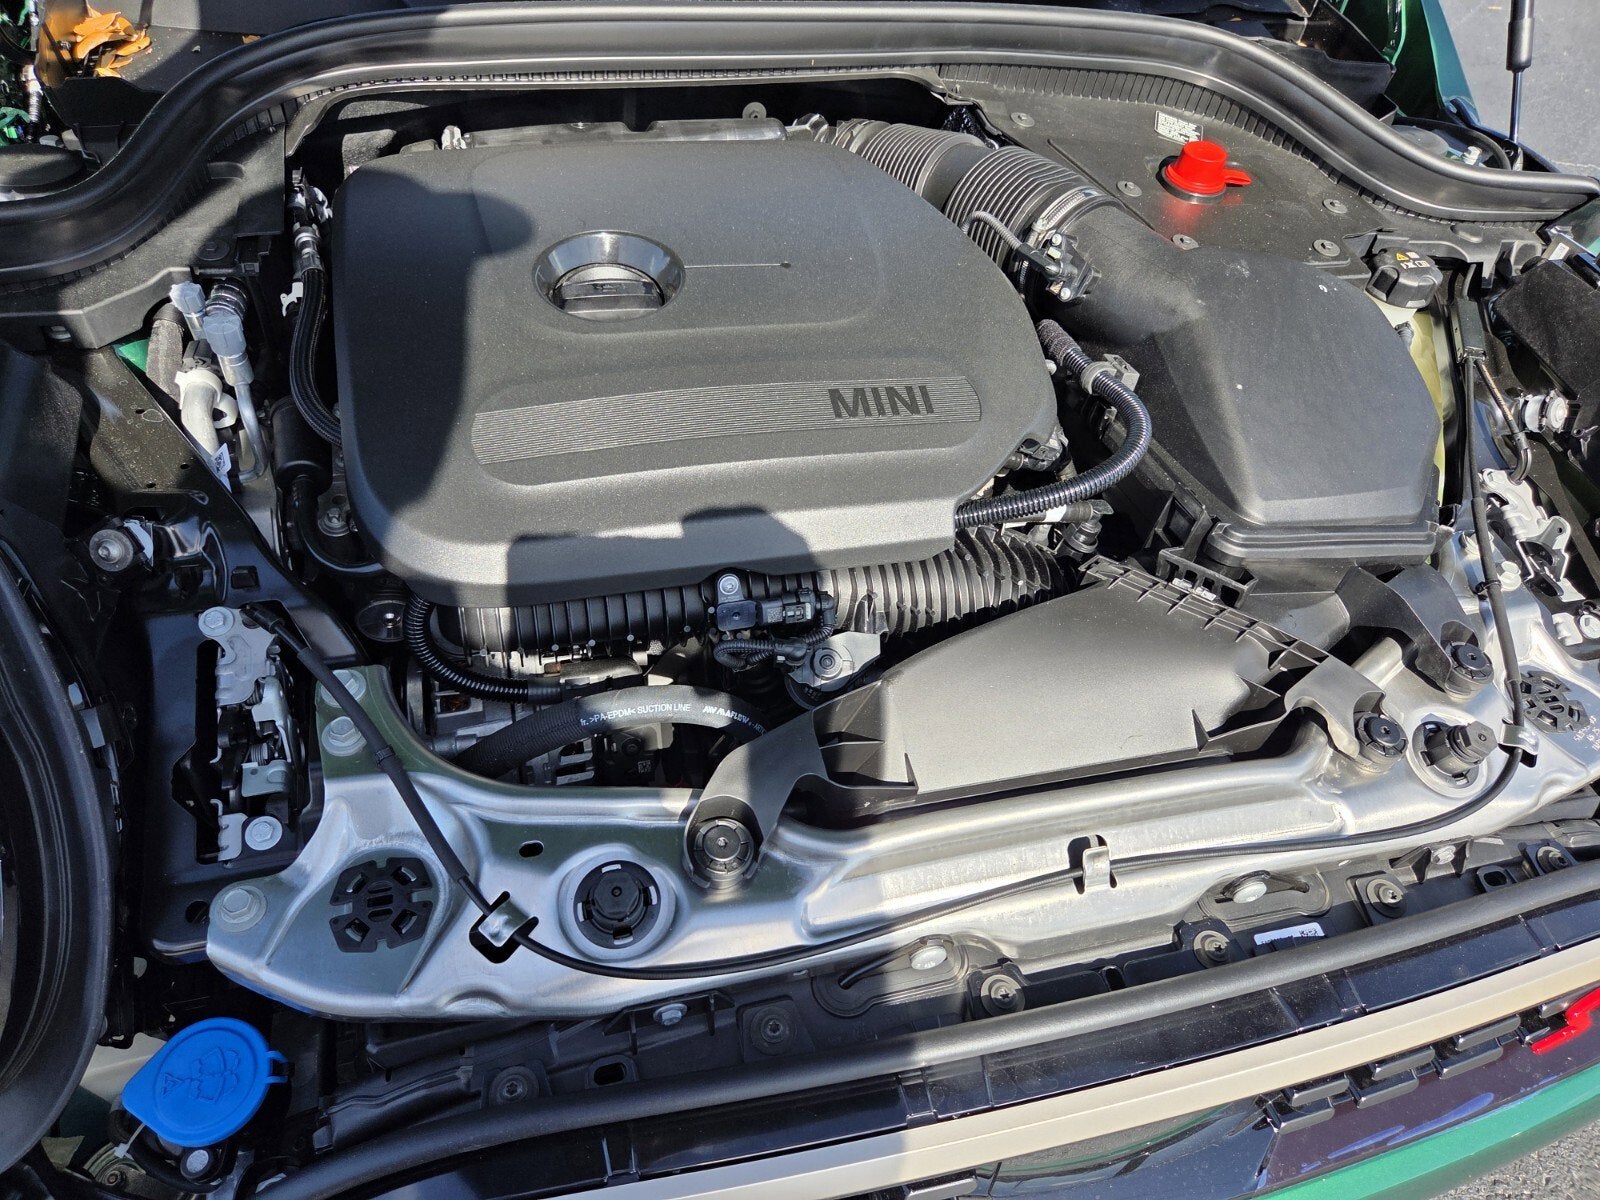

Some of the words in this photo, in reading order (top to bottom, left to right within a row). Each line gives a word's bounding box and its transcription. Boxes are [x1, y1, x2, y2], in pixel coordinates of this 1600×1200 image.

[827, 385, 935, 419] MINI
[637, 704, 673, 714] SUCTION
[674, 703, 692, 712] LINE
